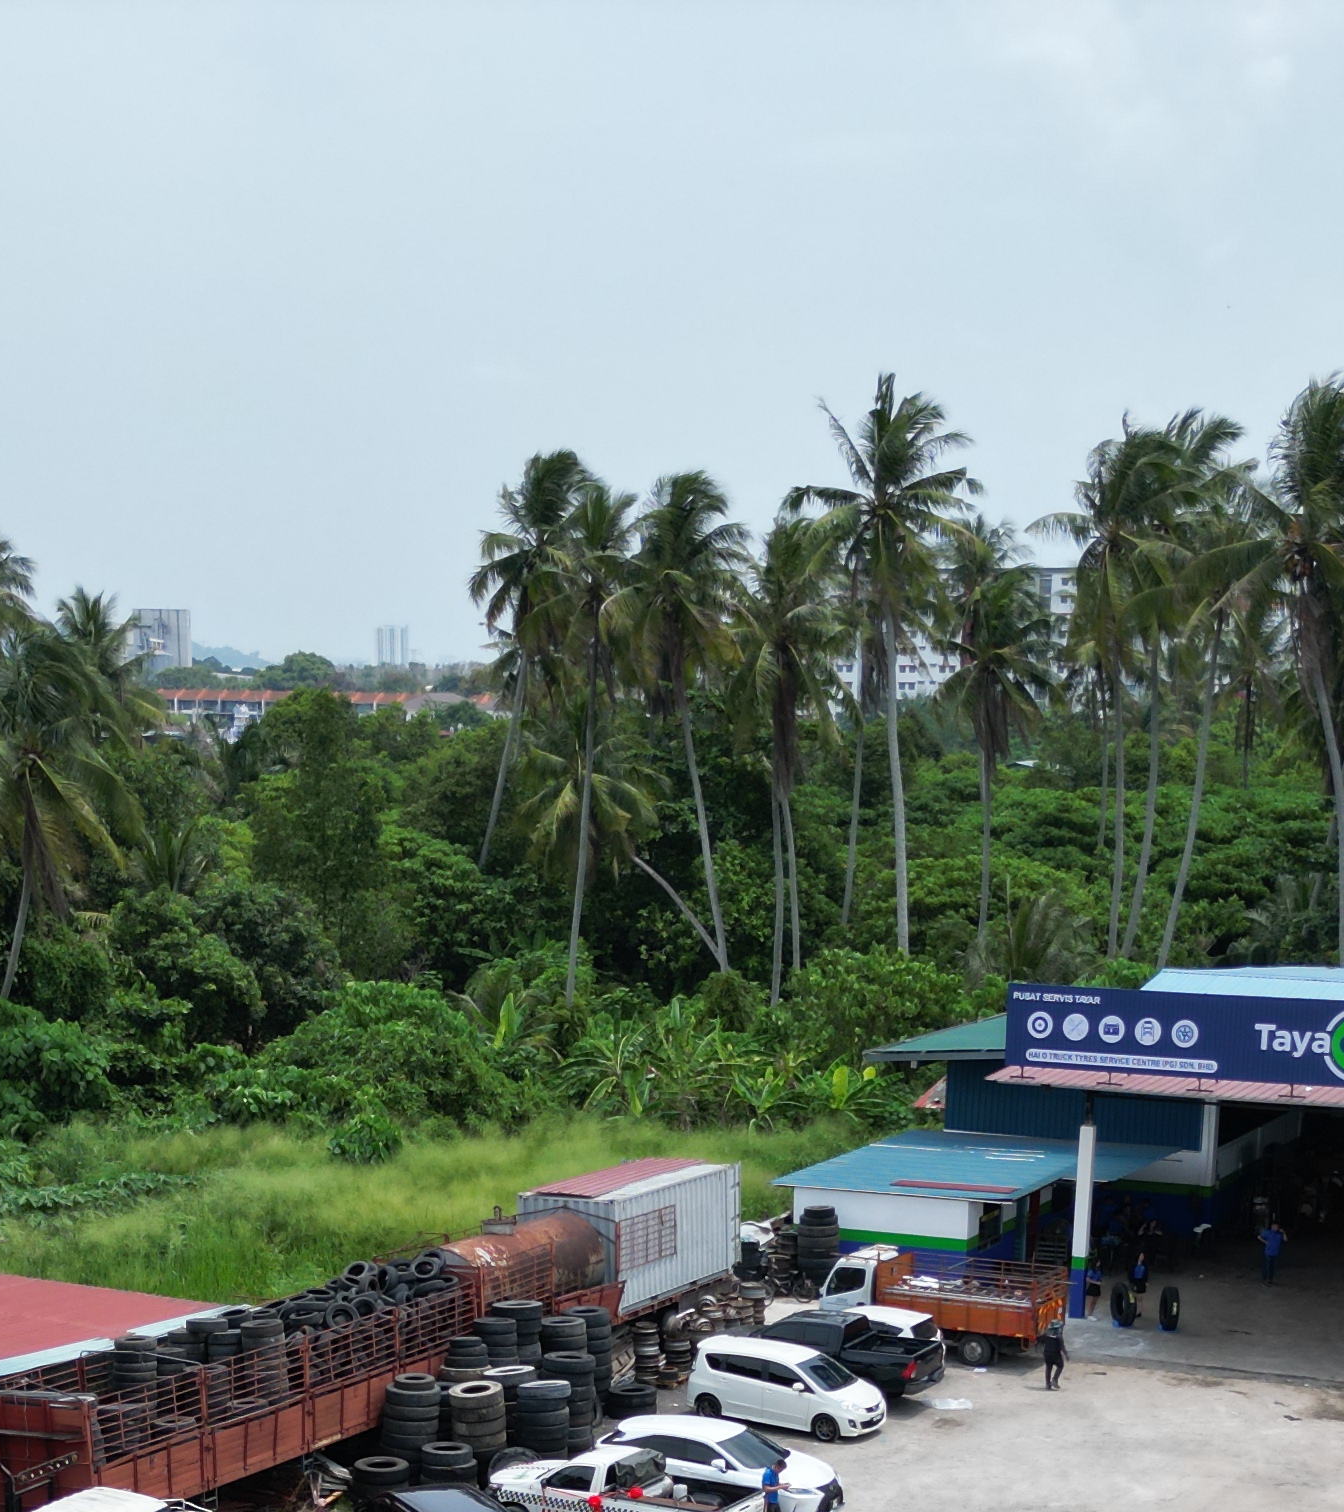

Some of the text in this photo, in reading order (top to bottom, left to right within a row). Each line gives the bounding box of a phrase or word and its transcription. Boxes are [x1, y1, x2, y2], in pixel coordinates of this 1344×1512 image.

[1013, 991, 1041, 1001] PUSAT
[1043, 993, 1073, 1003] SERVIS
[1049, 1052, 1073, 1061] TRUCK
[1075, 1054, 1098, 1063] TYRES
[1100, 1056, 1130, 1066] SERVICE
[1132, 1058, 1160, 1068] CENTRE
